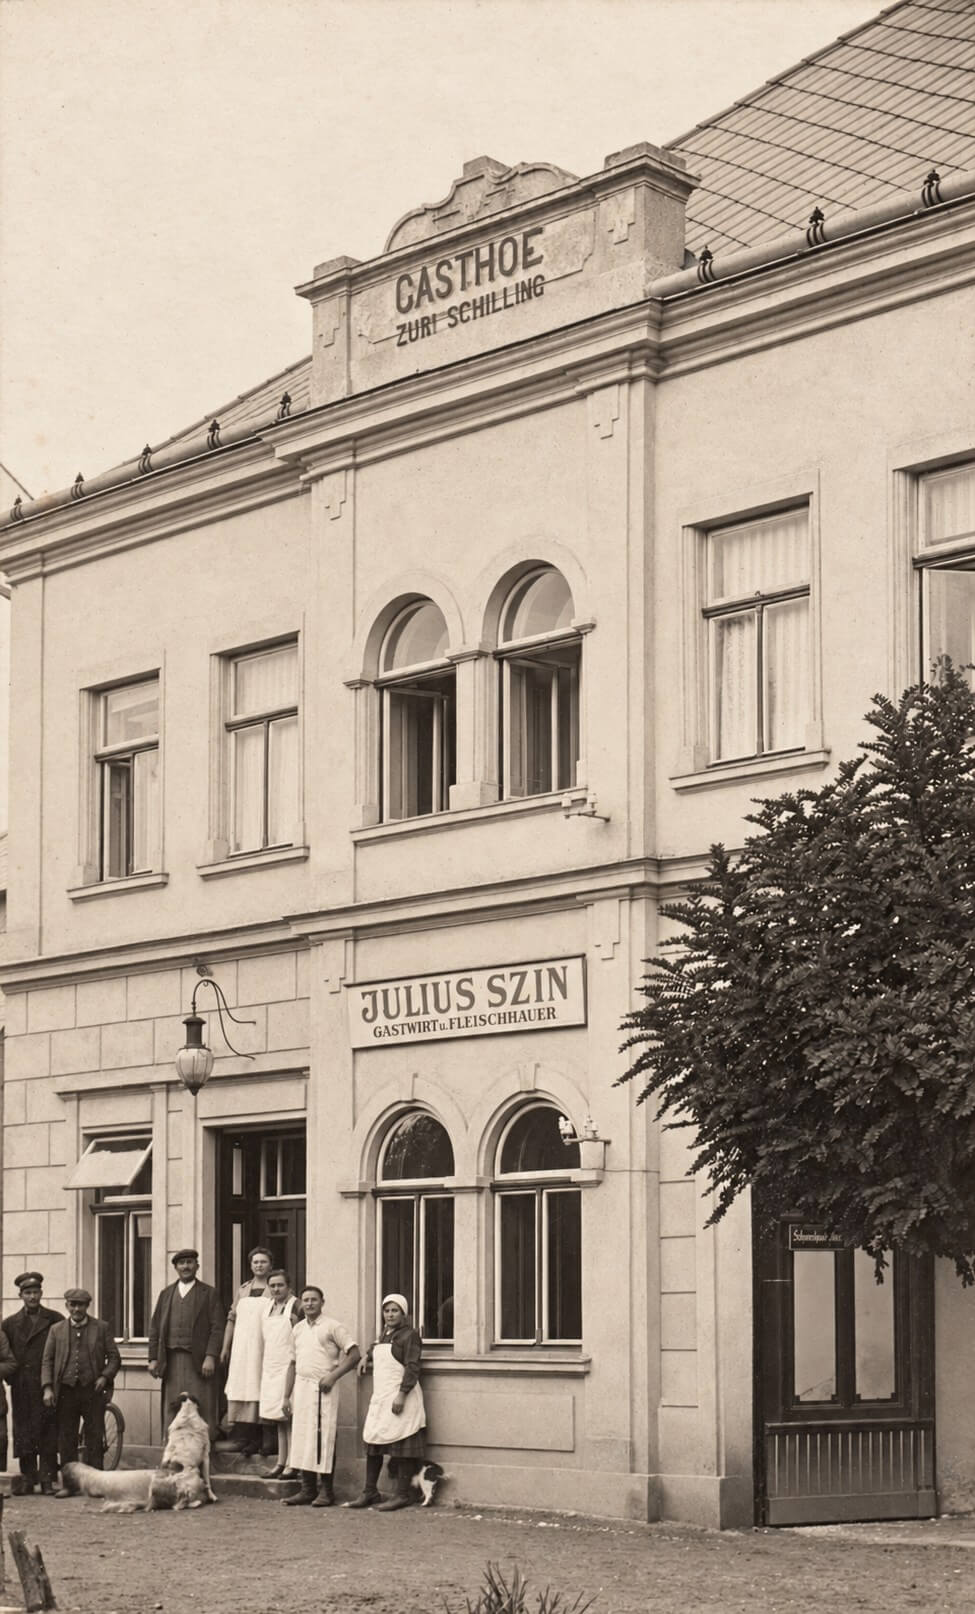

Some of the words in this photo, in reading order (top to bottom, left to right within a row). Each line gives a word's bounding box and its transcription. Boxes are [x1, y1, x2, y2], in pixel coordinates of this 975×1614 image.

[447, 274, 545, 328] SCHILLING
[361, 977, 476, 1023] JULIUS
[486, 965, 568, 1008] SZIN
[373, 1019, 439, 1038] GASTWIRT
[449, 1006, 557, 1030] FLEISCHHAUER
